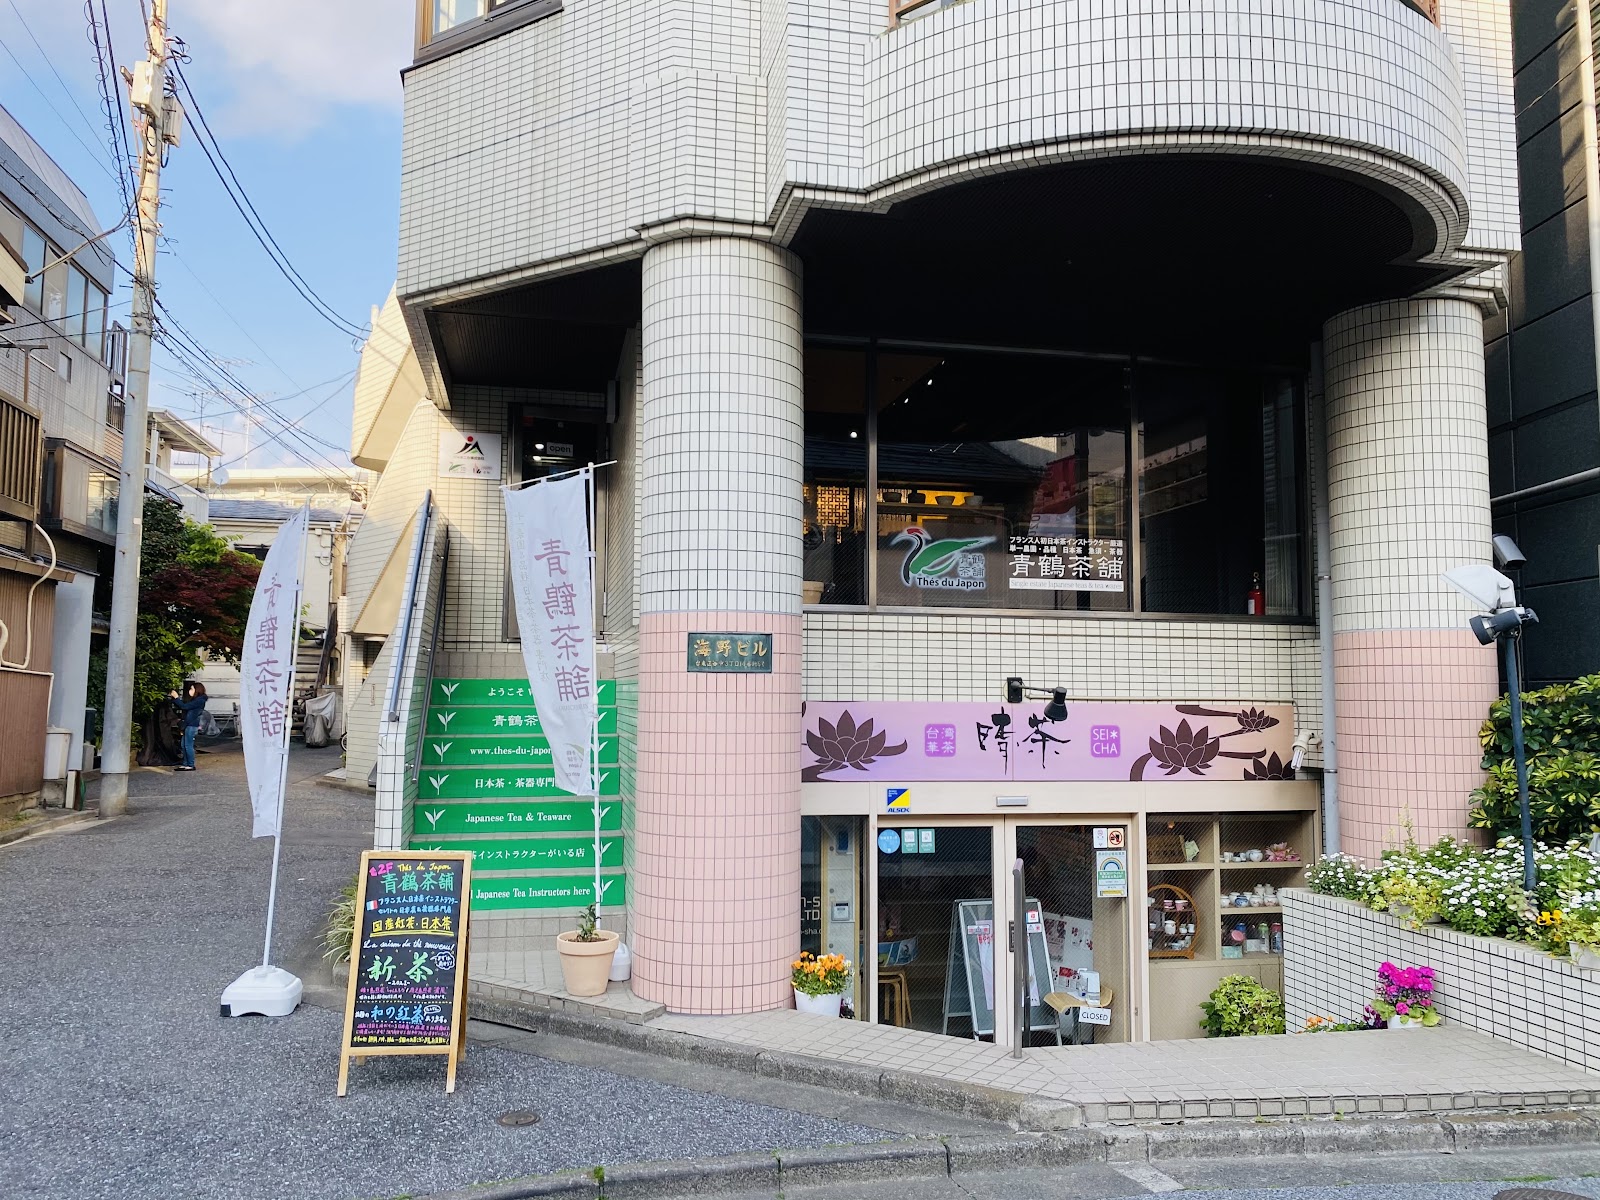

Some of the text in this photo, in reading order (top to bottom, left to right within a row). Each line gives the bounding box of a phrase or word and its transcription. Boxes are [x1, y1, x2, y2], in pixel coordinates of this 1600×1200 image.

[550, 446, 571, 454] open
[1063, 547, 1083, 555] 日本茶
[1009, 554, 1124, 579] 青鶴茶舗
[917, 576, 985, 590] Thés du Japon
[1010, 580, 1028, 588] Single
[1048, 581, 1074, 590] Japanese
[694, 638, 768, 657] 海野ビル
[488, 688, 524, 697] ようこそ
[926, 728, 955, 739] 台湾
[1092, 742, 1118, 754] CHA
[465, 812, 572, 824] Japanese Tea & Teaware
[378, 862, 394, 876] 2F
[380, 872, 455, 894] 青鶴茶舗
[476, 889, 510, 900] Japanese
[513, 888, 526, 898] Tea
[529, 887, 571, 897] Instructors
[574, 886, 590, 896] here
[367, 952, 434, 983] 新茶
[370, 1004, 425, 1024] 和の紅茶
[1082, 1012, 1108, 1021] CLOSED
